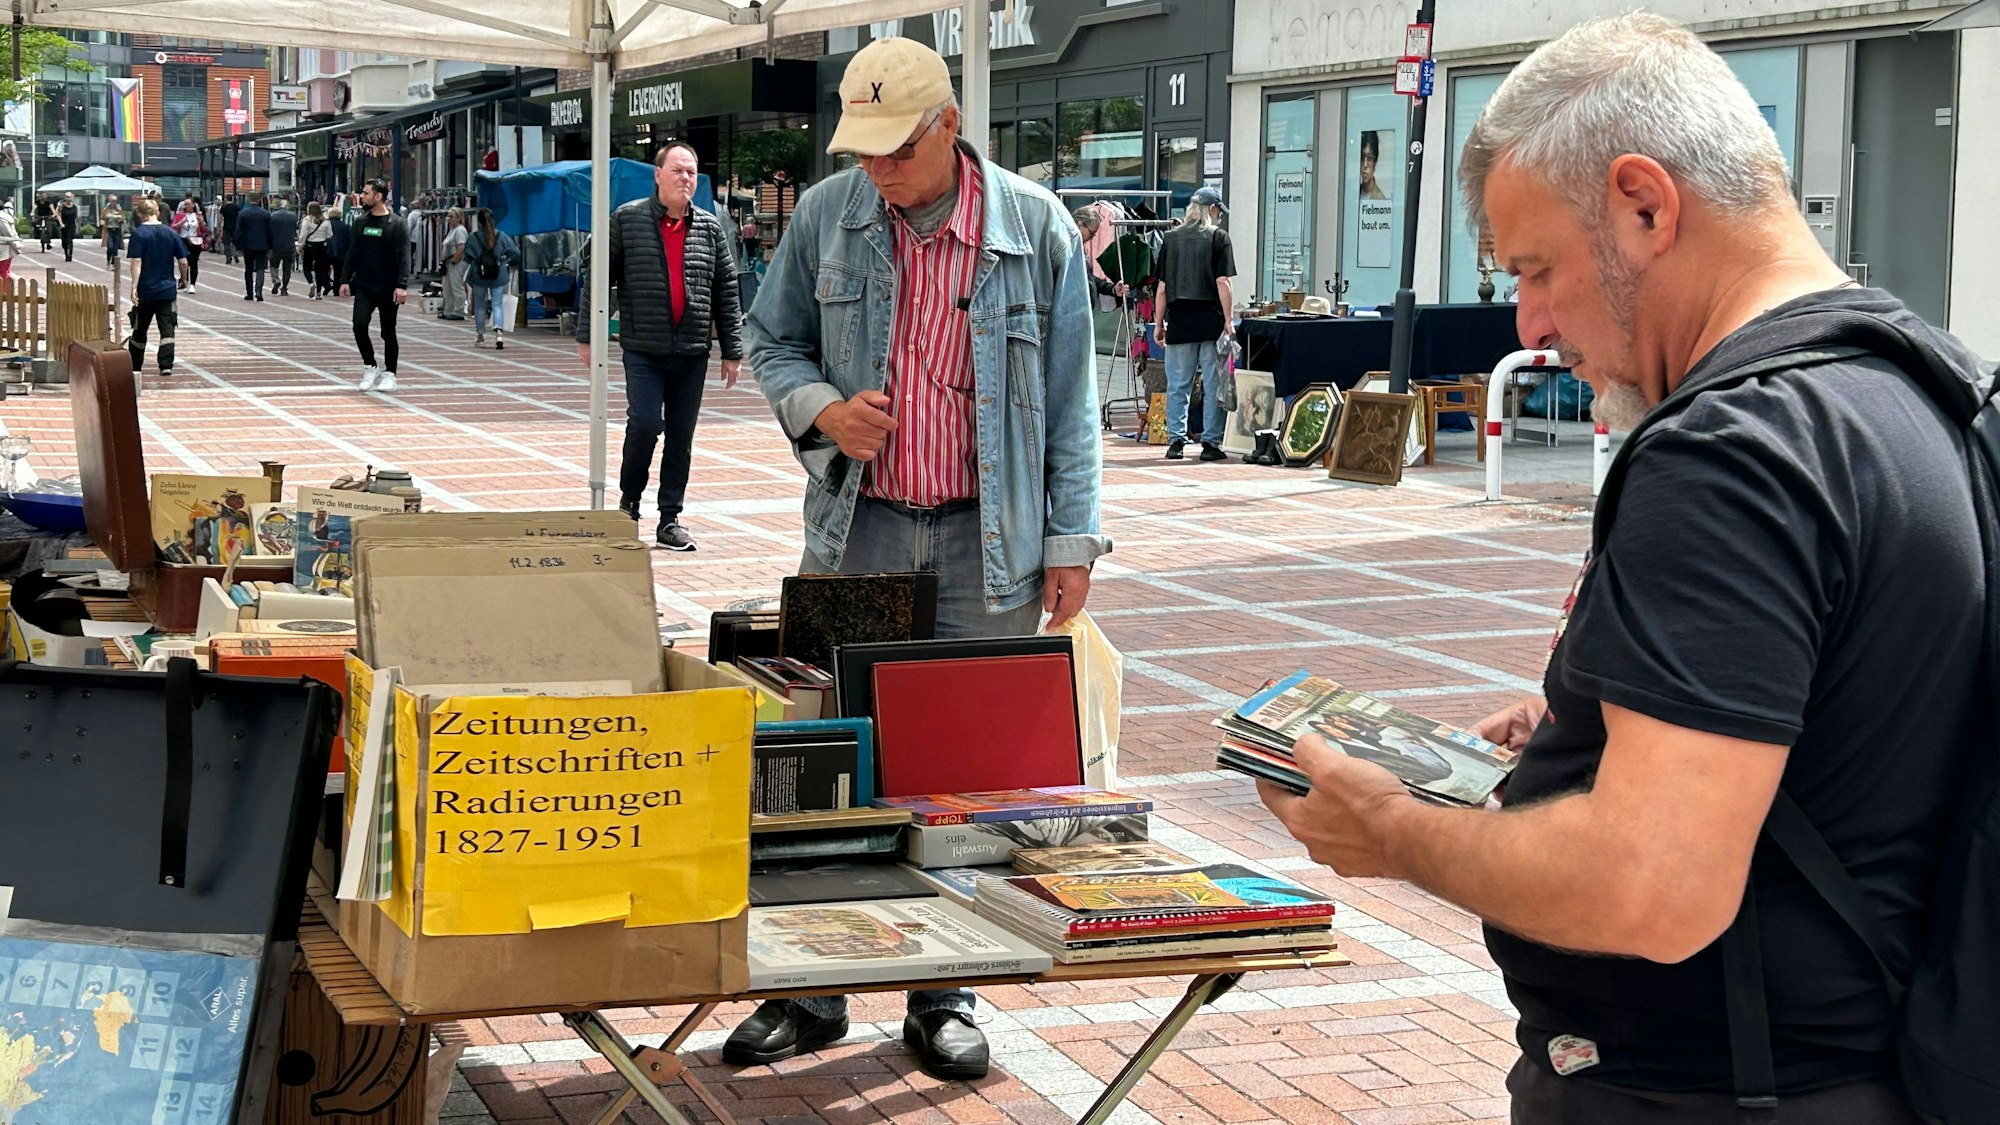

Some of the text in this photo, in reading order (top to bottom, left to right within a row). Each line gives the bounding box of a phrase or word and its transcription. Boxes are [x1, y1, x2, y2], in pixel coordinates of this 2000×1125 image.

[273, 91, 306, 100] TLS
[628, 81, 683, 117] LEVERKUSEN
[1168, 73, 1186, 106] 11
[405, 110, 443, 139] Trendy
[1361, 204, 1392, 215] Fielmann
[1361, 220, 1378, 230] baut
[312, 498, 326, 506] Wie
[337, 501, 353, 509] Welt
[433, 711, 648, 740] Zeitungen,
[432, 743, 721, 775] Zeitschriften +
[432, 788, 683, 816] Radierungen
[935, 814, 963, 825] TOPP
[435, 824, 643, 854] 1827-1951
[945, 834, 967, 844] eins
[952, 844, 998, 859] Auswahl
[20, 975, 37, 988] 6
[52, 977, 69, 991] 7
[152, 981, 172, 1005] 10
[209, 991, 222, 1015] ARAL
[227, 1009, 242, 1034] Alles
[140, 1036, 159, 1054] 11
[175, 1037, 194, 1059] 12
[196, 1095, 216, 1117] 14
